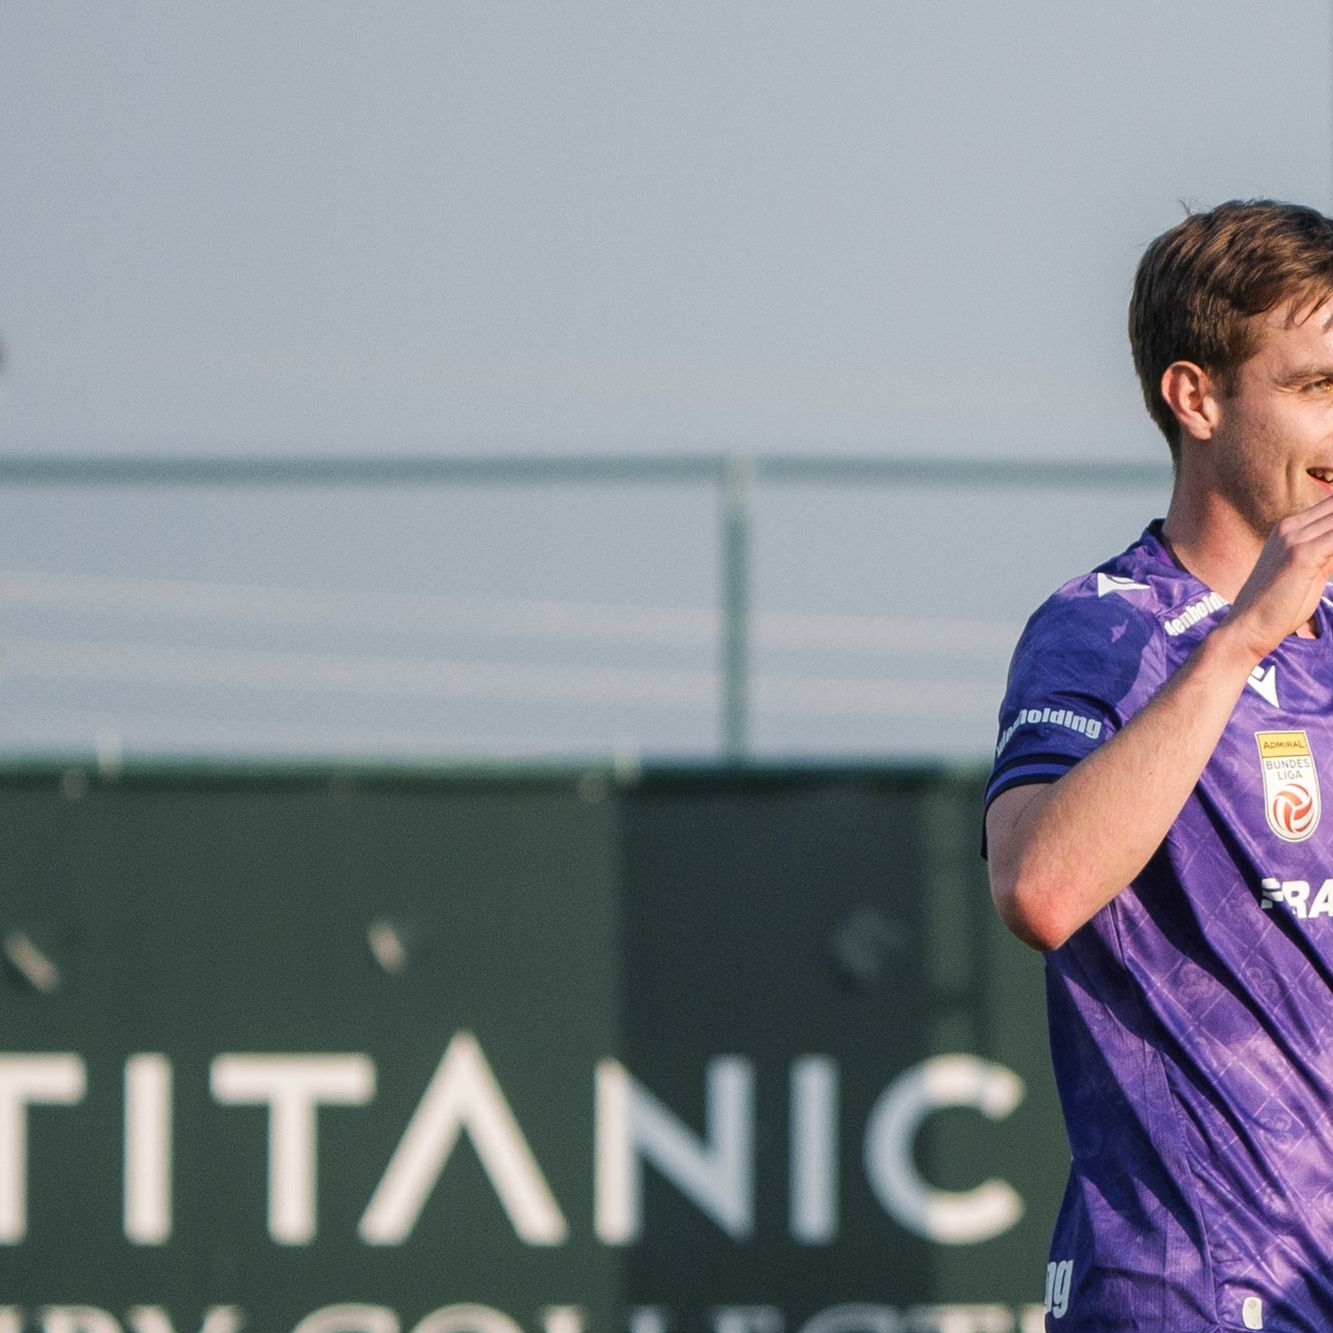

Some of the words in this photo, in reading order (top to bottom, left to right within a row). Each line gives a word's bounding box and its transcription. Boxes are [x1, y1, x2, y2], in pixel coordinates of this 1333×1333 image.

[1263, 740, 1304, 750] ADMIRAL
[1265, 758, 1311, 770] BUNDES
[1277, 770, 1303, 780] LIGA
[0, 1030, 1026, 1248] TITANIC
